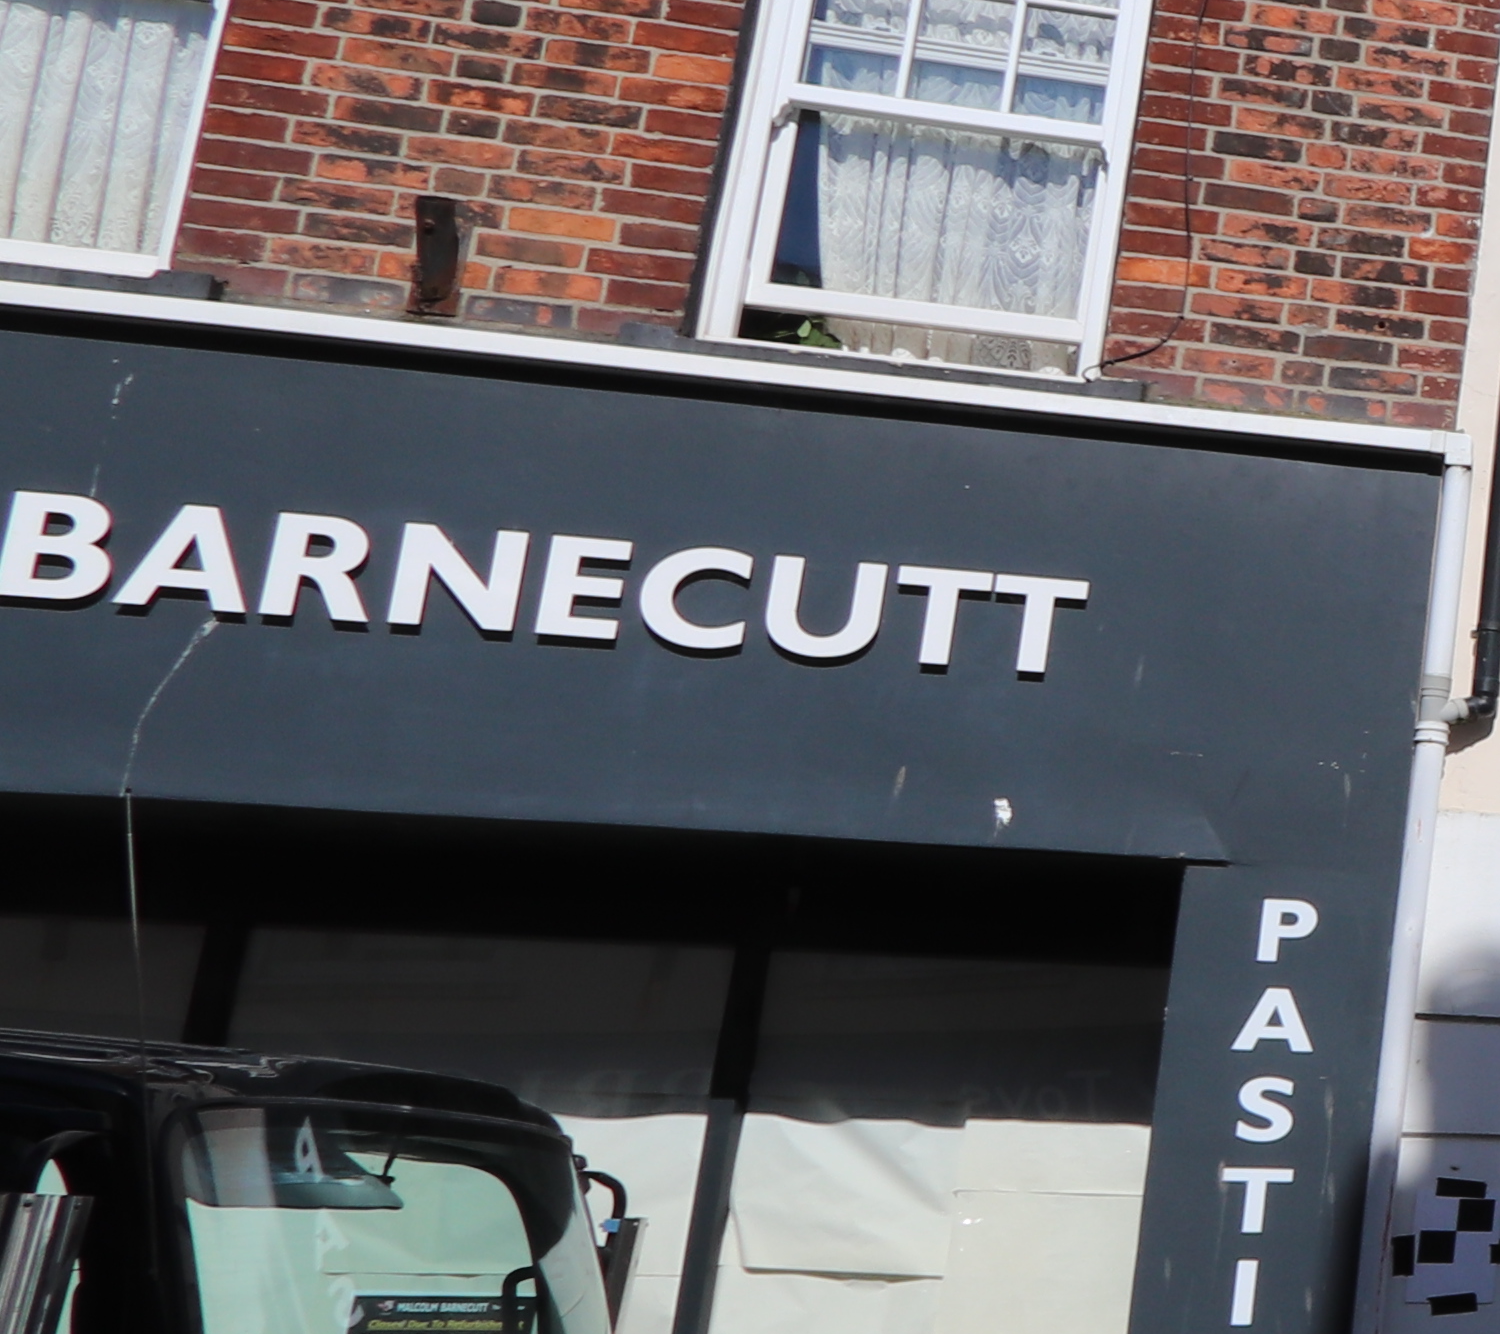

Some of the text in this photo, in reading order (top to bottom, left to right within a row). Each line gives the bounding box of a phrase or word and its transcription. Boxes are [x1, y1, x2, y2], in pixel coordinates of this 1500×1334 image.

[0, 489, 1092, 679] BARNECUTT
[397, 1302, 438, 1313] MALCOLM
[440, 1302, 490, 1313] BARNECUTT
